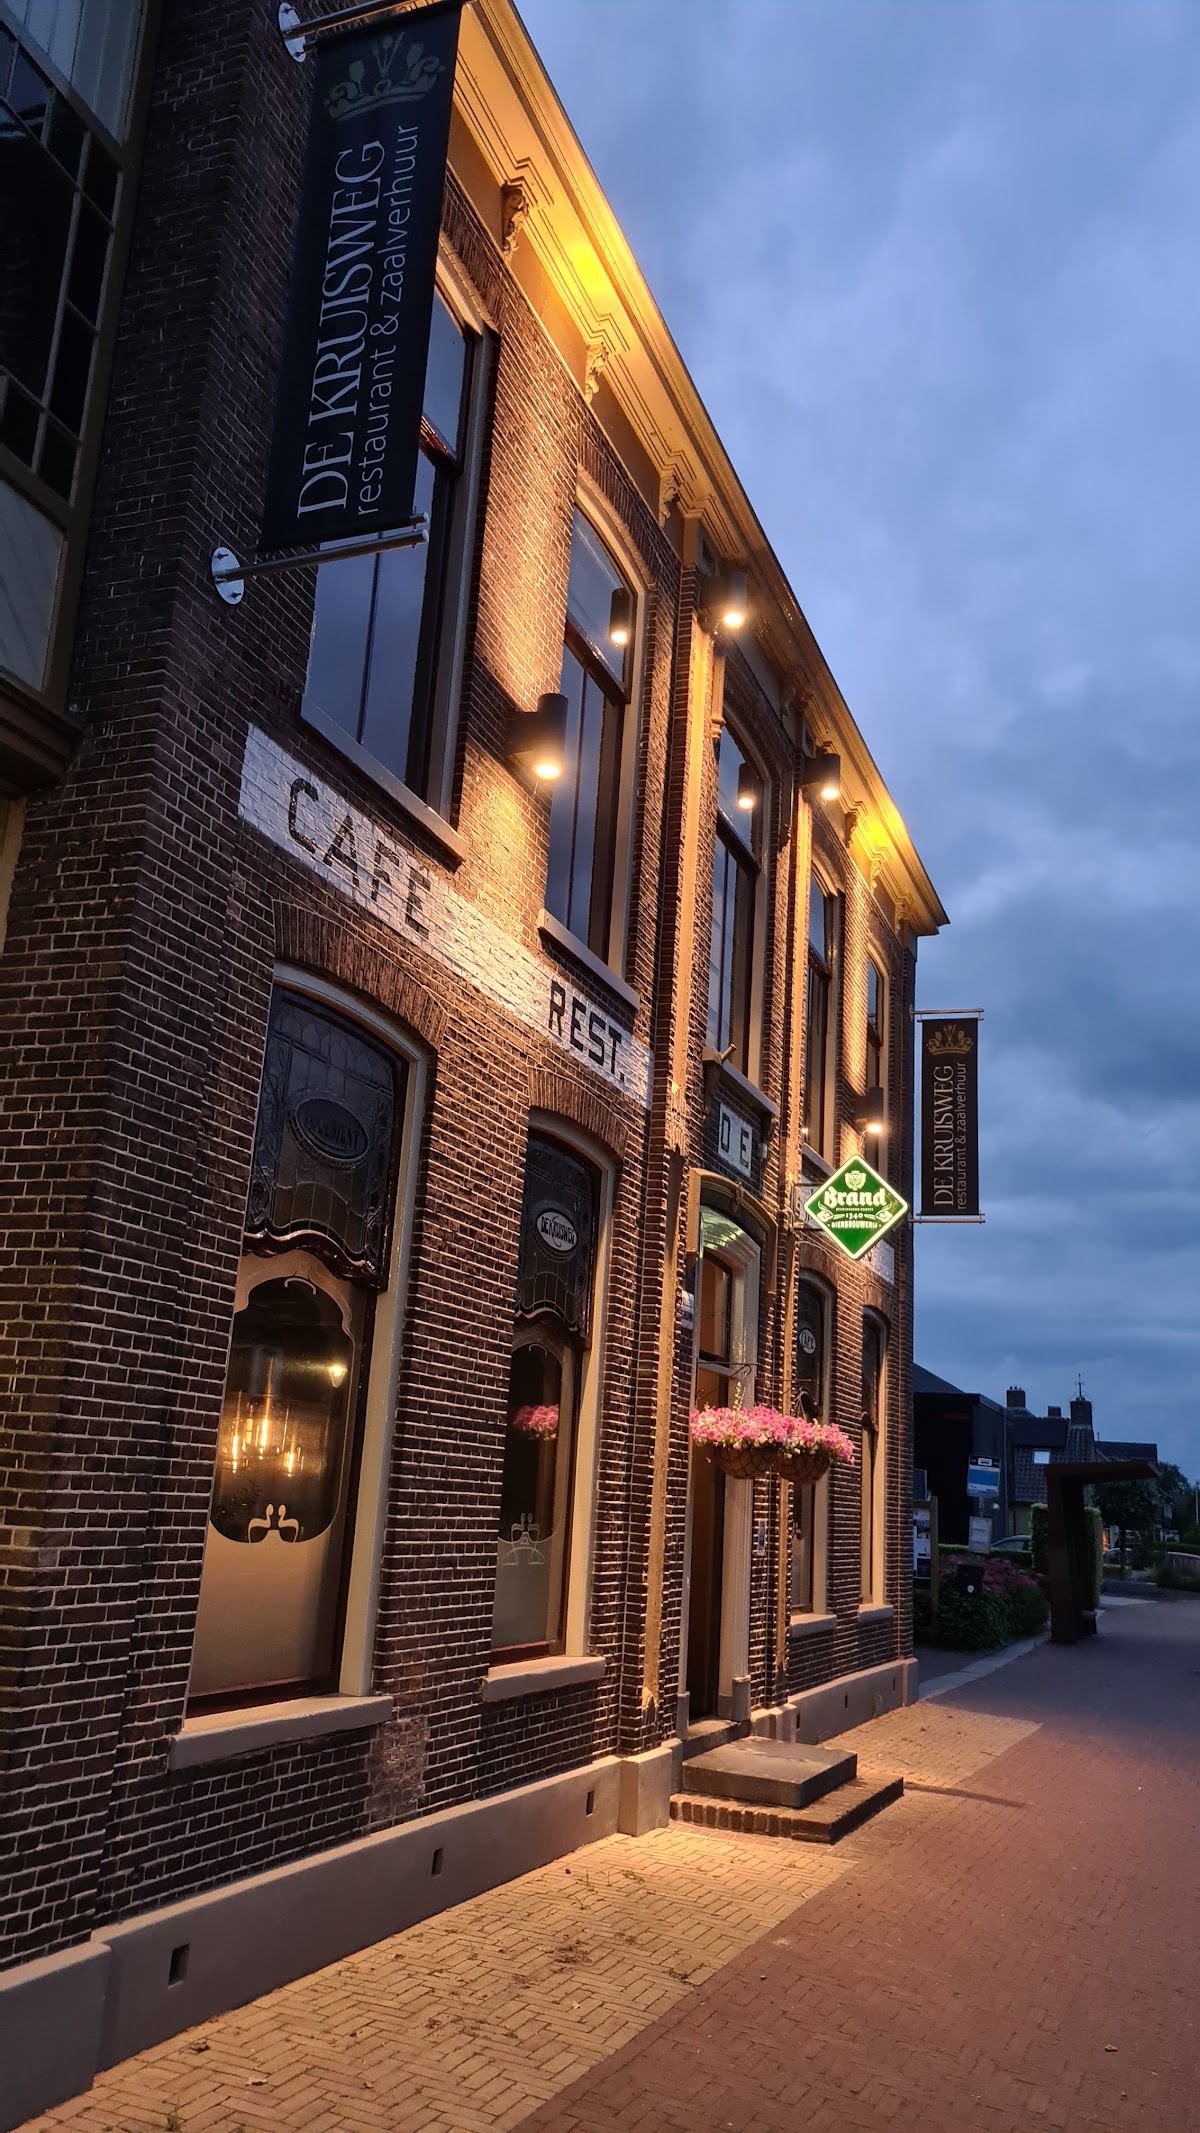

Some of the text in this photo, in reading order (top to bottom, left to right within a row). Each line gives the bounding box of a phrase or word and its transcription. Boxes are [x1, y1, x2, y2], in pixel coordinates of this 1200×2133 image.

[297, 139, 385, 518] DE KRUISWEG
[357, 125, 419, 516] restaurant & zaalverhuur
[548, 979, 625, 1082] REST.
[721, 1112, 750, 1170] DE
[933, 1065, 954, 1206] DE KRUISWEG
[954, 1062, 968, 1210] restaurant & zaalverhuur
[824, 1186, 887, 1209] Brand
[831, 1220, 878, 1229] BIERBROUWERIJ
[845, 1212, 864, 1220] 1340
